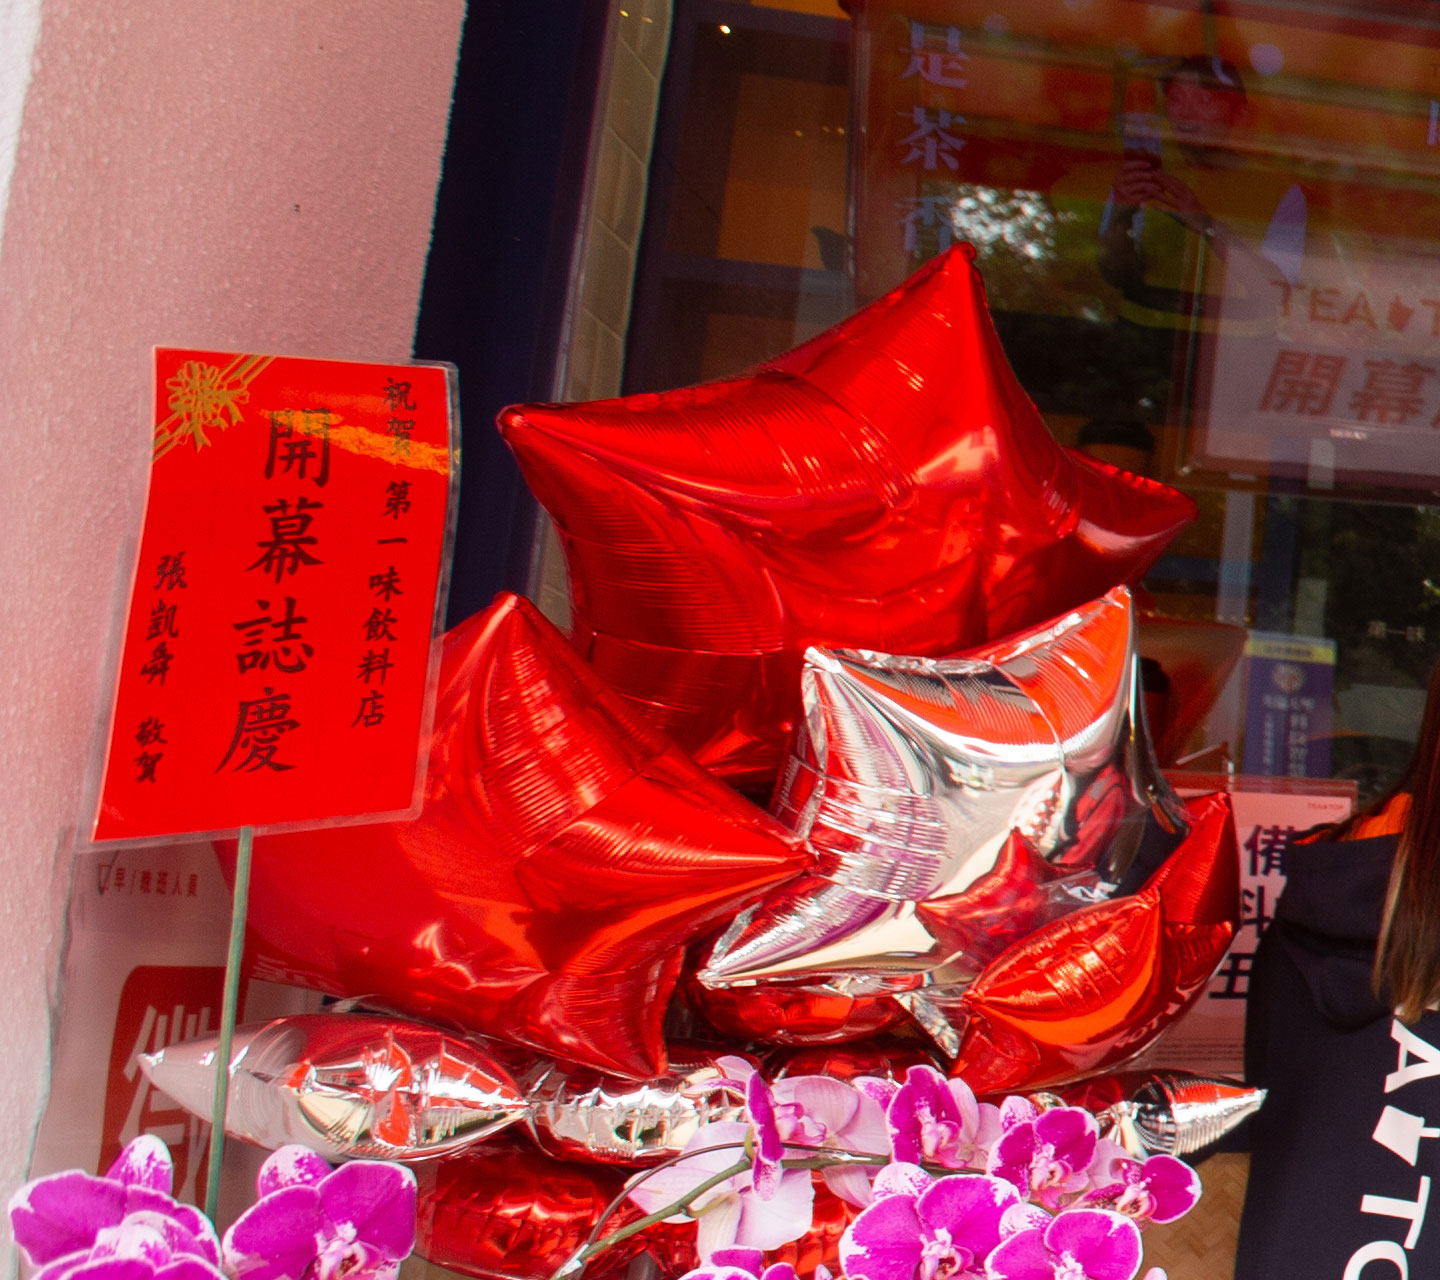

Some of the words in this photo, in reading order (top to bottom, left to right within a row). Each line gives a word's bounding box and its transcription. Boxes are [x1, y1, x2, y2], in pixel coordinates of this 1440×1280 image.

[1270, 279, 1378, 331] TEA
[382, 375, 418, 460] 祝賀
[214, 405, 332, 776] 開幕誌慶
[351, 480, 413, 730] 第一味飲料店
[134, 716, 168, 784] 敬賀
